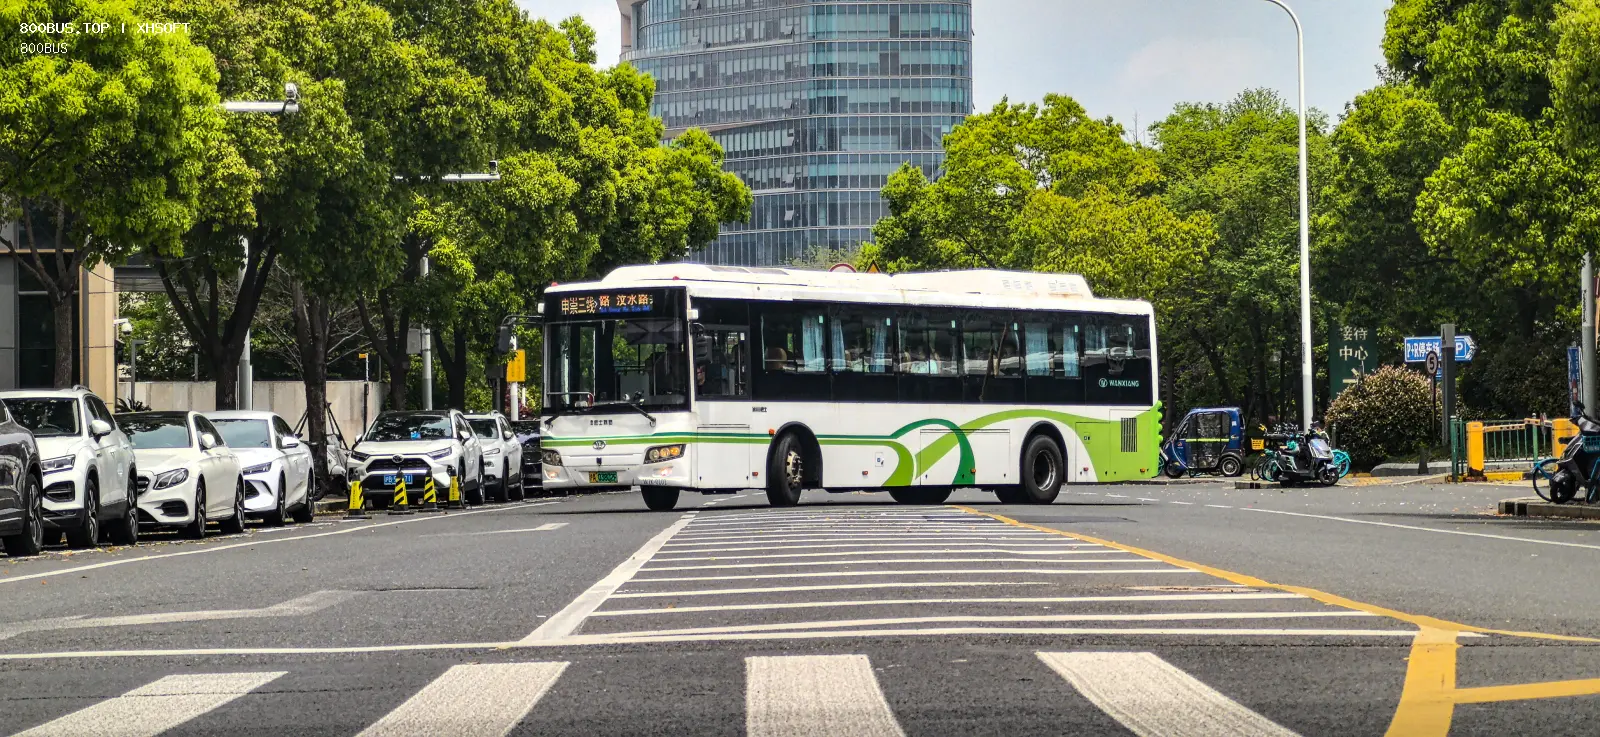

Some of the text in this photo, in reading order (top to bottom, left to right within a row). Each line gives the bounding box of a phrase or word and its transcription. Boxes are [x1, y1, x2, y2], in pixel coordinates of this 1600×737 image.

[1338, 325, 1368, 341] 接待
[1339, 345, 1369, 361] 中心
[1428, 356, 1435, 370] 5
[1109, 379, 1139, 387] WANXIANG
